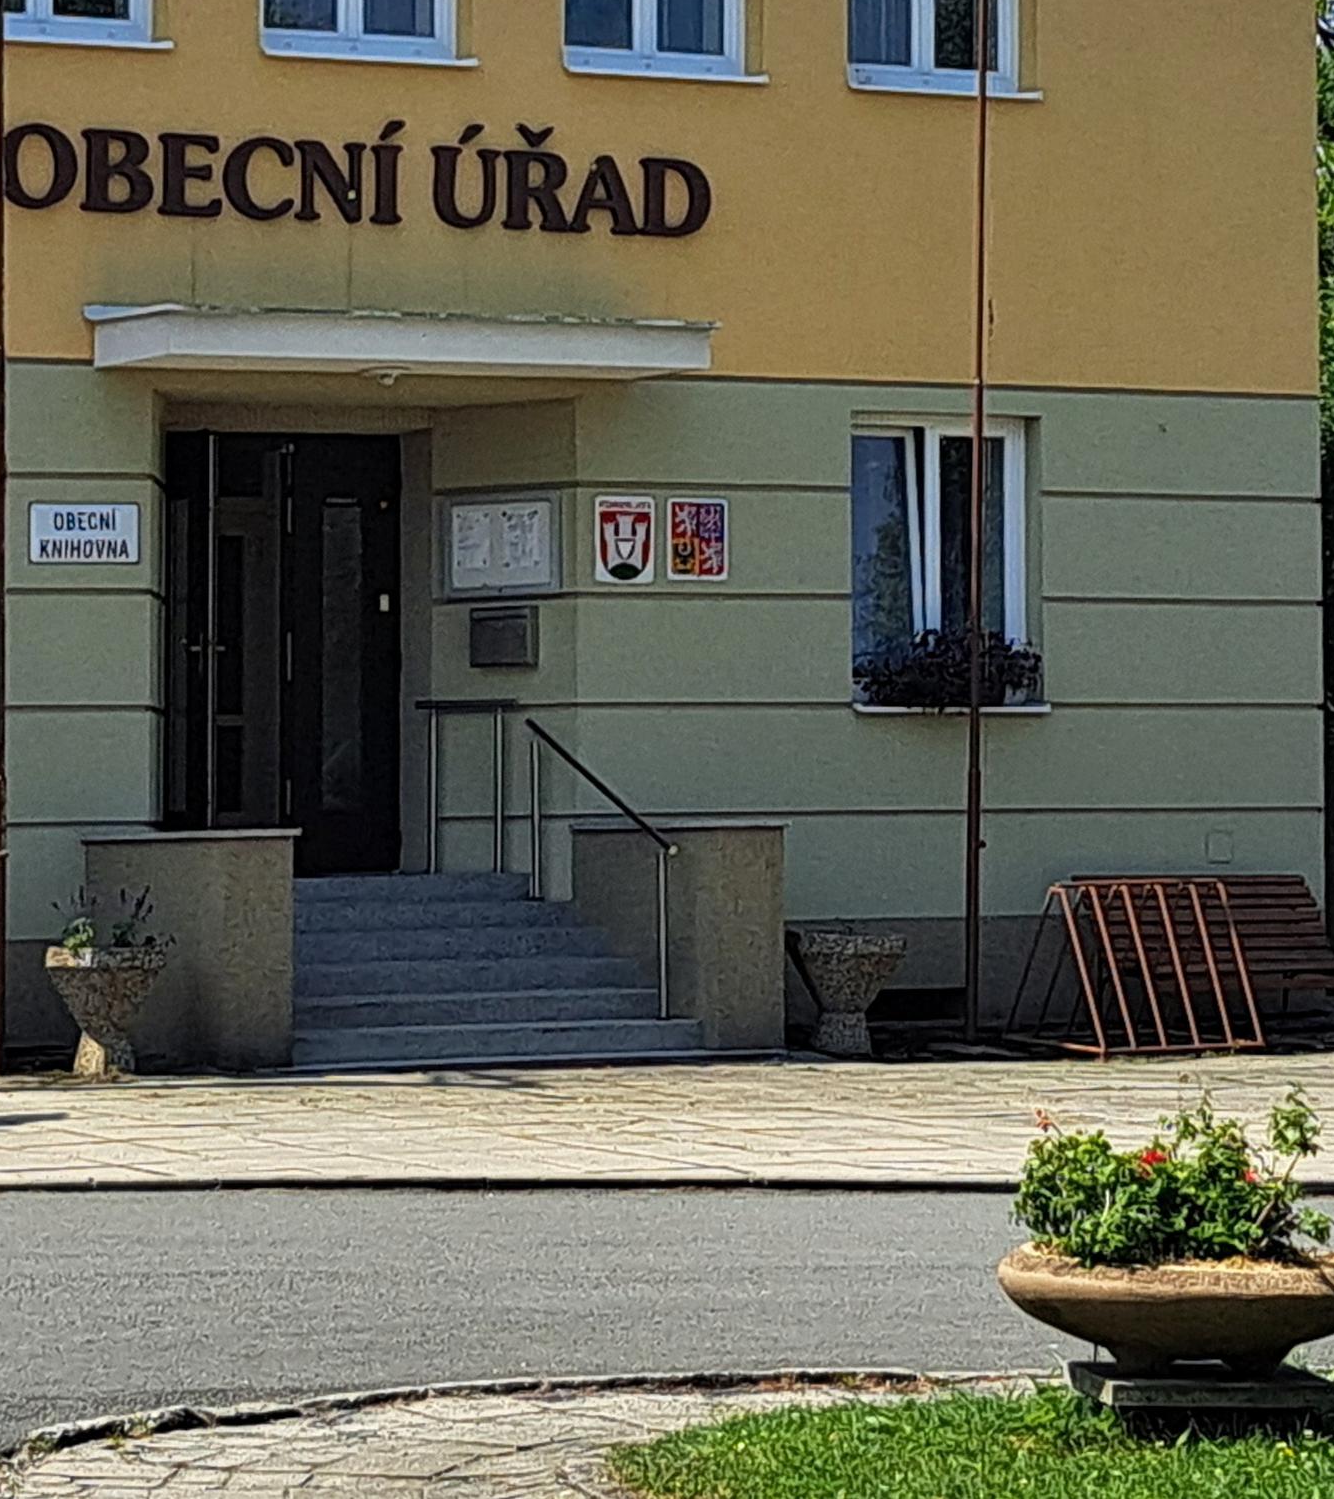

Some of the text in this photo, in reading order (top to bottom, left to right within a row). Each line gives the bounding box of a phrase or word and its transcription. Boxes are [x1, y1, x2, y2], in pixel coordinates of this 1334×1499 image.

[431, 123, 712, 236] ÚŘAD
[53, 507, 117, 531] OBECNÍ
[39, 539, 130, 559] KNIHOVNA
